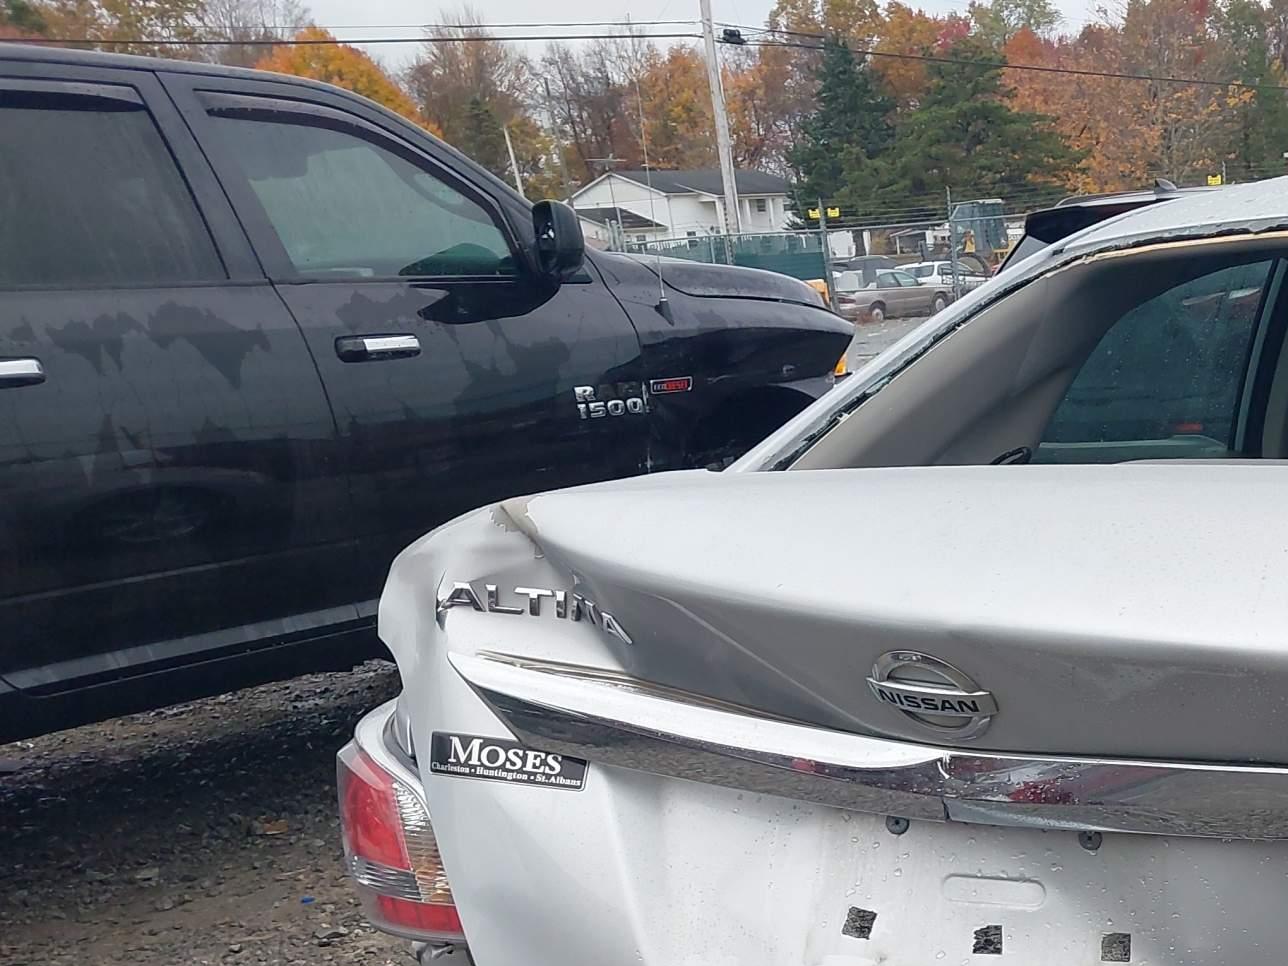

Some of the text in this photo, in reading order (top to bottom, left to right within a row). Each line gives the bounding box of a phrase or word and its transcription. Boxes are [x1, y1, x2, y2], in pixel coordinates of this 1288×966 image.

[576, 397, 643, 420] 1500
[438, 582, 633, 644] ALTIMA
[878, 688, 980, 713] NISSAN
[448, 736, 562, 774] MOSES
[431, 761, 470, 774] Charleston
[476, 766, 528, 780] Huntington
